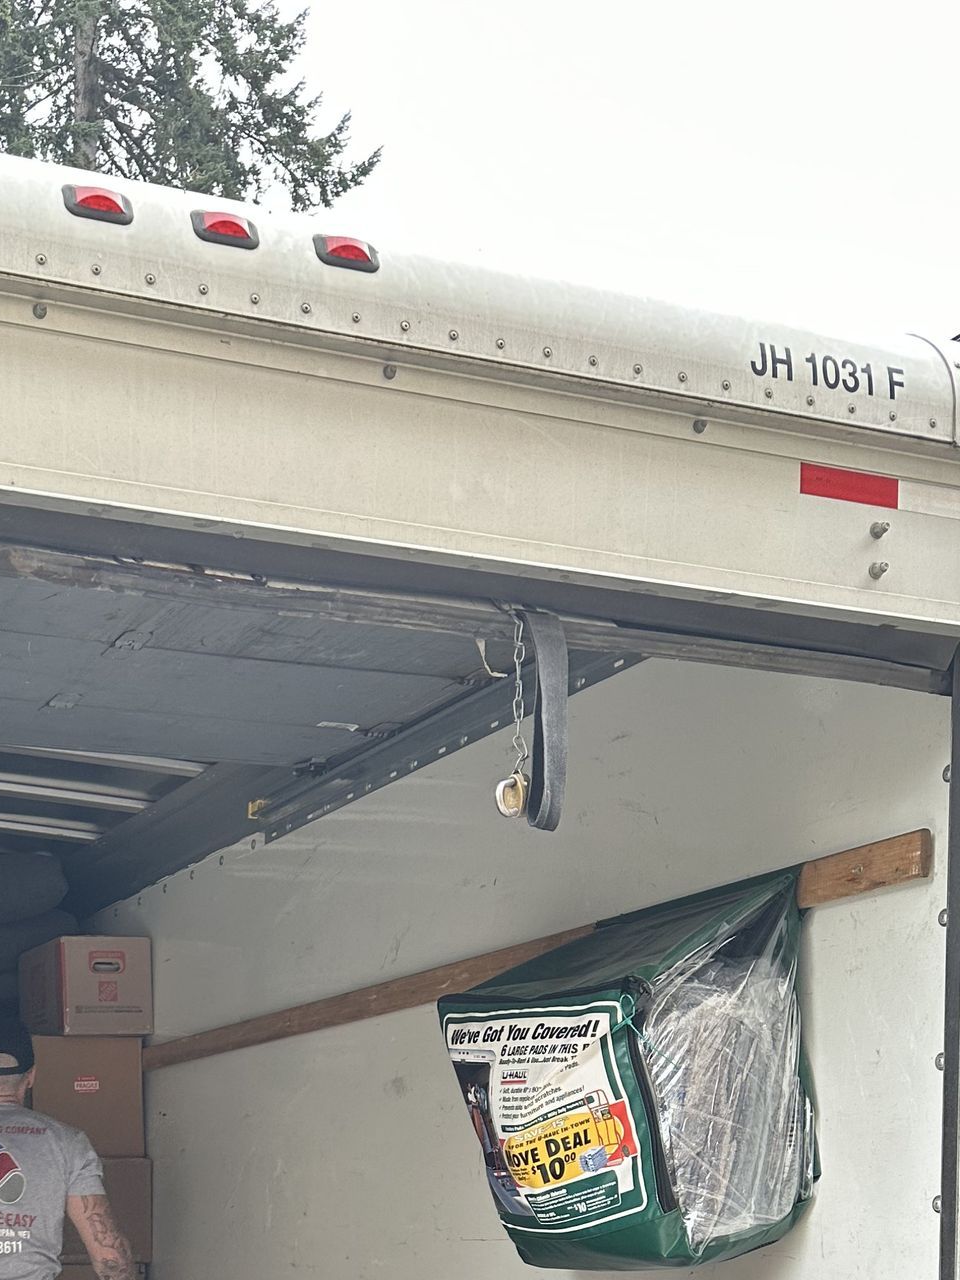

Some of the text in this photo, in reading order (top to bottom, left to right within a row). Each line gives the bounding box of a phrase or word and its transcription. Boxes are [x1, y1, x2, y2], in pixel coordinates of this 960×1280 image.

[750, 342, 905, 400] JH 1031 F
[450, 1019, 600, 1046] We've Got You Covered!
[500, 1044, 508, 1057] 6
[508, 1045, 528, 1056] LARGE
[528, 1044, 549, 1055] PADS
[548, 1044, 558, 1054] IN
[558, 1043, 578, 1054] THIS
[502, 1070, 528, 1080] U-HAUL
[544, 1098, 556, 1106] and
[5, 1126, 47, 1135] COMPANY
[505, 1128, 592, 1168] MOVE DEAL
